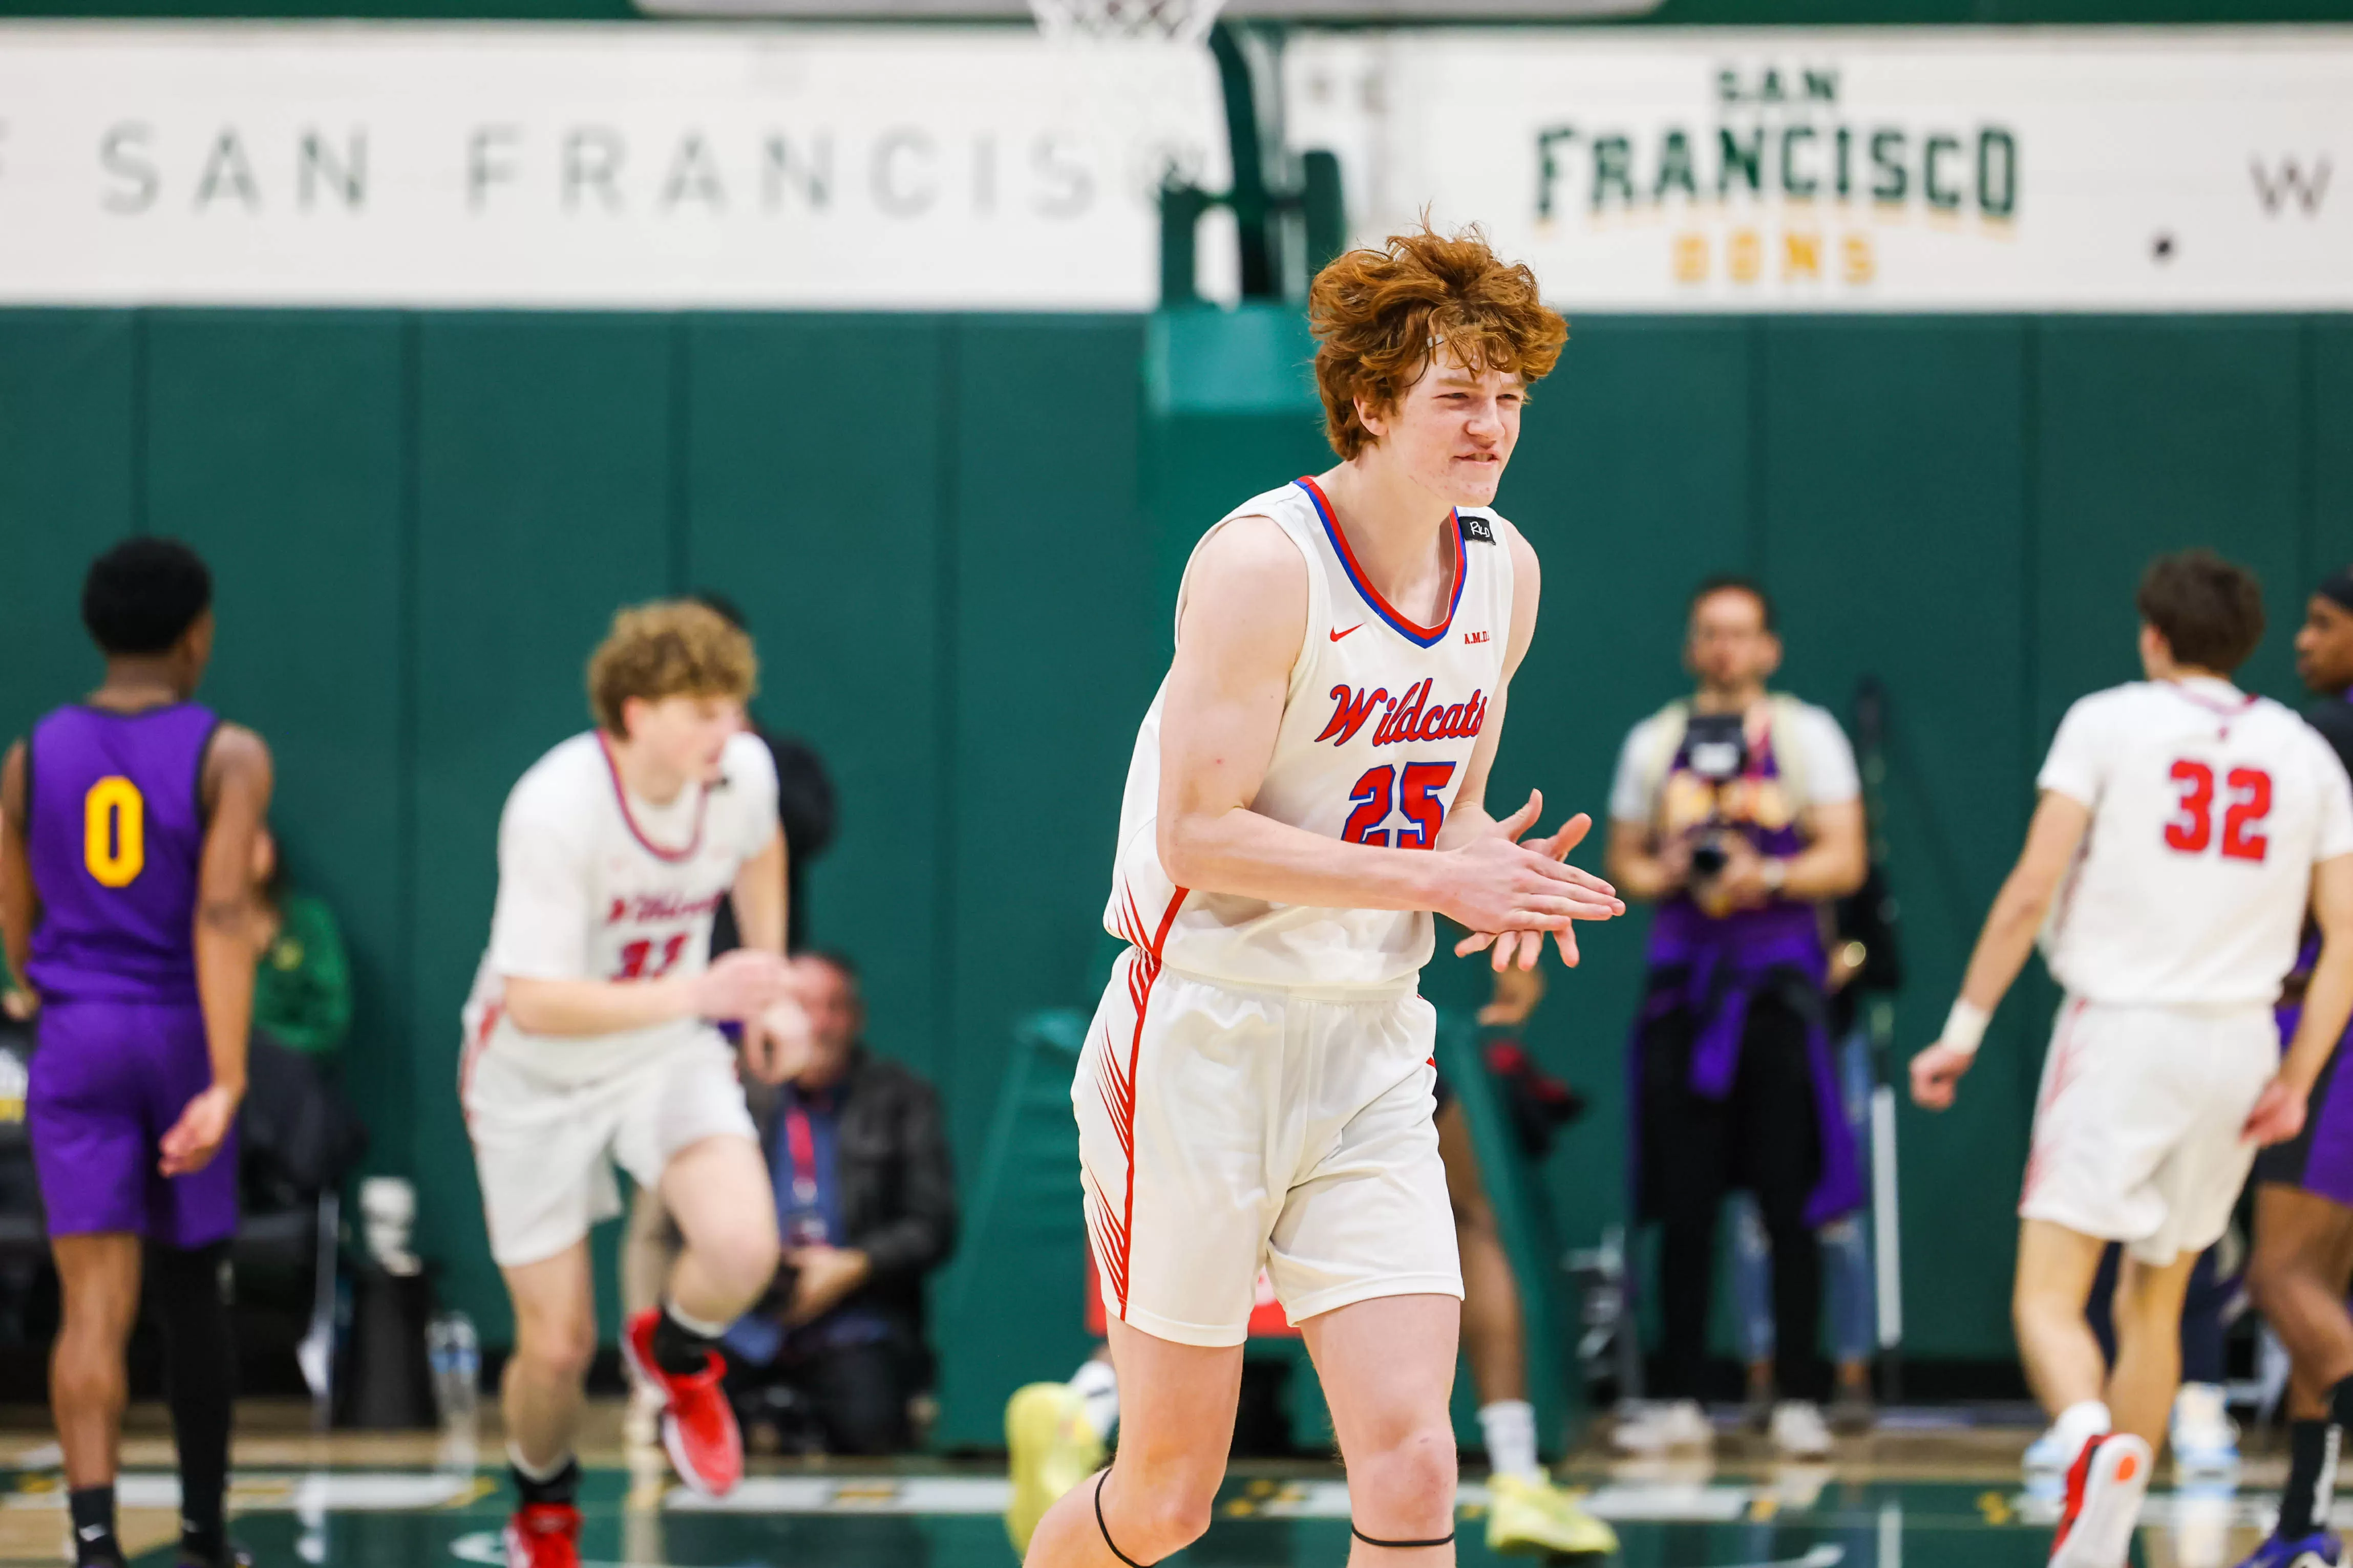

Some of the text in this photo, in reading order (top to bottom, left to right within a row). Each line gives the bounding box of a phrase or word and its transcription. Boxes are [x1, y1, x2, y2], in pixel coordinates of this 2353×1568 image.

[1713, 65, 1842, 104] SAN
[97, 120, 369, 216] SAN
[462, 122, 1196, 220] FRANCIS
[1532, 124, 2020, 223] FRANCISCO
[1672, 229, 1876, 286] DONS
[1314, 677, 1487, 747] Wildcats
[83, 775, 144, 888] 0
[1341, 761, 1457, 850] 25
[2163, 758, 2273, 863] 32
